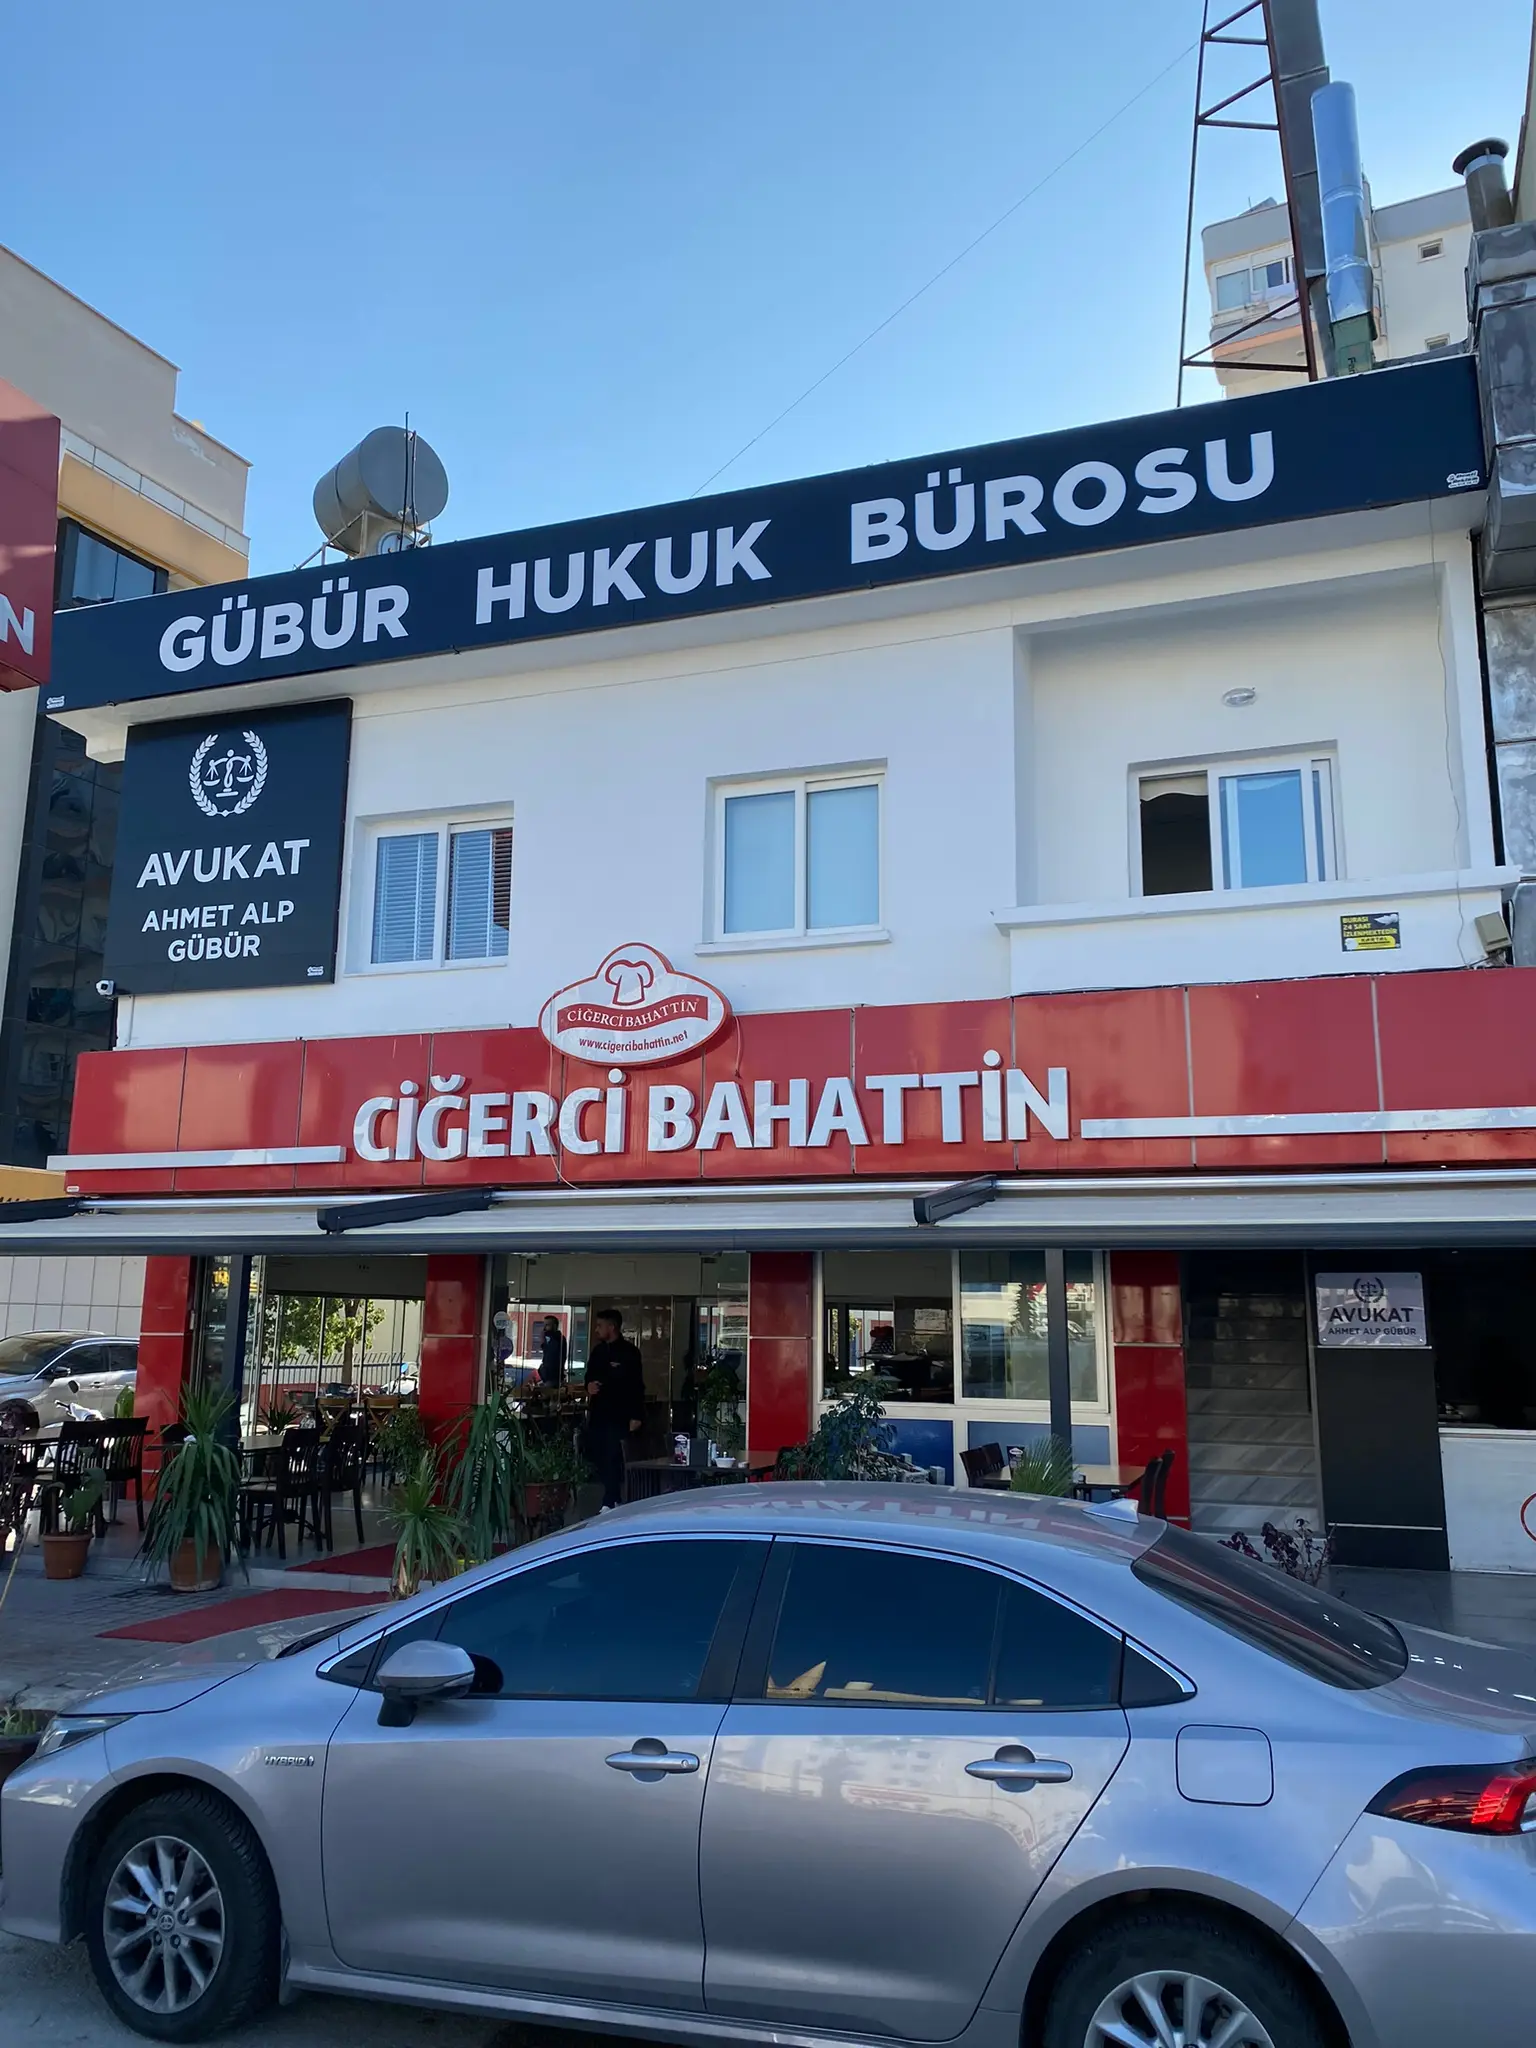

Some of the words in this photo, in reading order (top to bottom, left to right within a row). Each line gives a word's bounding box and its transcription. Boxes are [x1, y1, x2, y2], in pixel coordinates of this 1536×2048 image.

[159, 577, 410, 674] GÜBÜR
[474, 520, 773, 626] HUKUK
[850, 431, 1276, 564] BÜROSU
[137, 839, 310, 888] AVUKAT
[142, 905, 233, 932] AHMET
[240, 901, 295, 925] ALP
[168, 931, 260, 962] GÜBÜR
[567, 1009, 624, 1027] CİĞERCİ
[625, 999, 698, 1027] BAHATTİN
[579, 1030, 689, 1054] www.cigercibahattin.net
[353, 1068, 627, 1163] CİĞERCİ
[647, 1050, 1069, 1152] BAHATTİN
[1329, 1308, 1414, 1322] AVUKAT
[1328, 1327, 1360, 1335] AHMET
[1363, 1327, 1382, 1335] ALP
[1383, 1326, 1417, 1335] GÜBÜR
[265, 1756, 306, 1765] HYBRID
